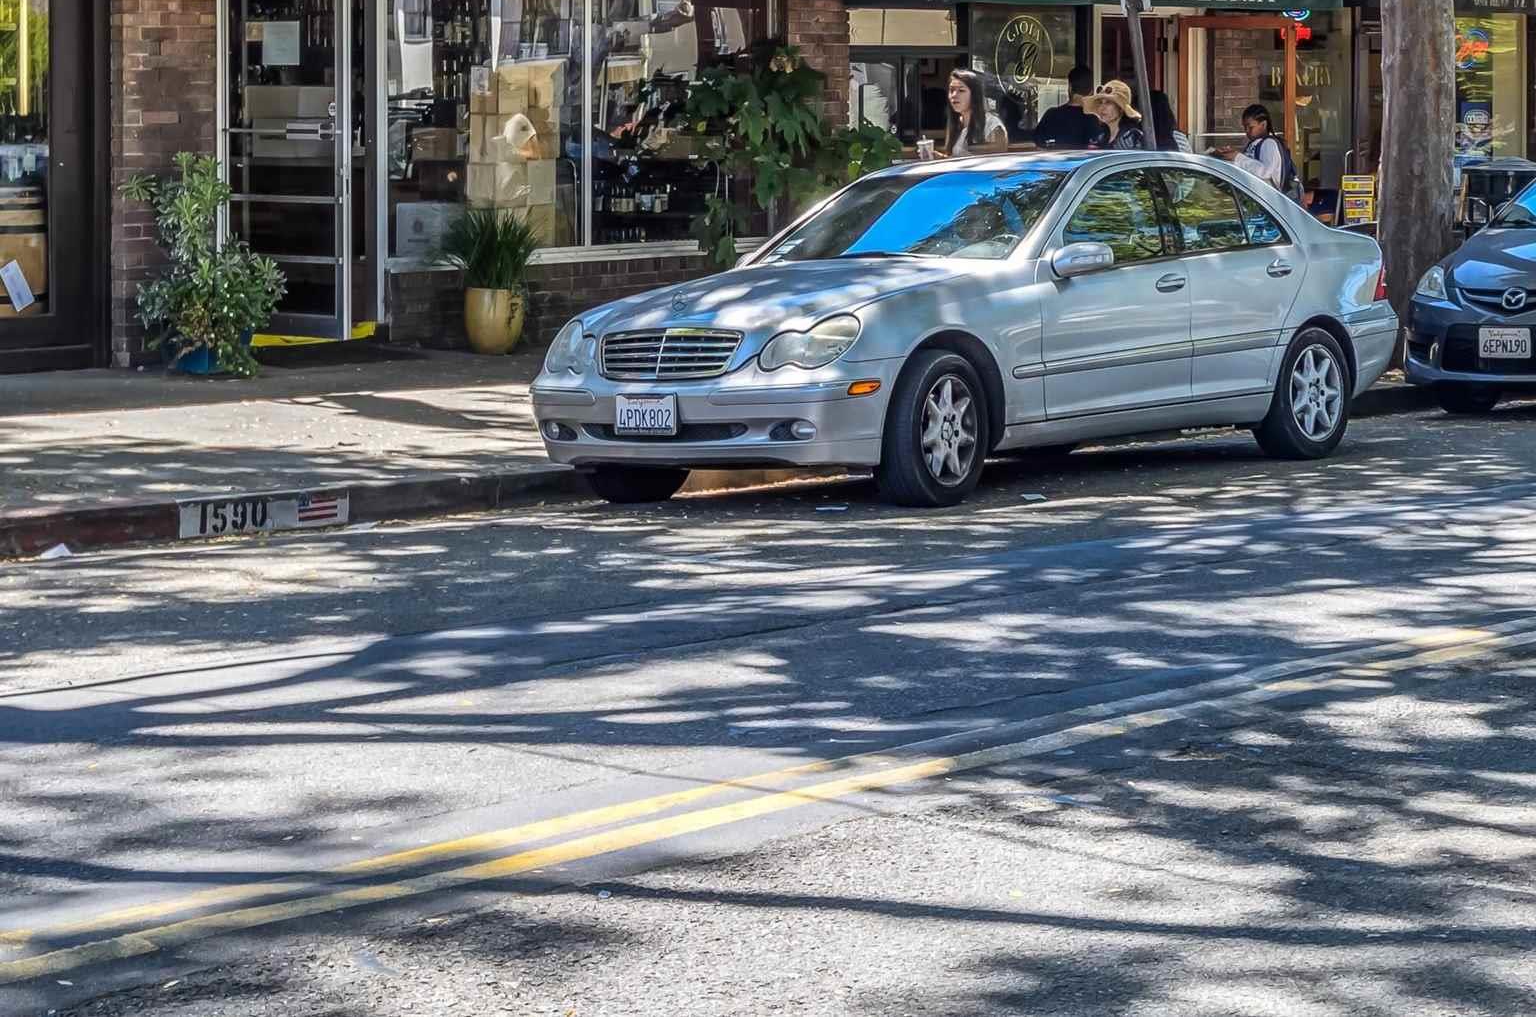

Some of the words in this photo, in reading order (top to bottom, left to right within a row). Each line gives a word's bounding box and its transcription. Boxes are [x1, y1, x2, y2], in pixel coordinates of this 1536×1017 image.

[1483, 339, 1527, 353] 6EPN190
[619, 408, 672, 428] 4PDK802
[200, 500, 268, 534] 1590
